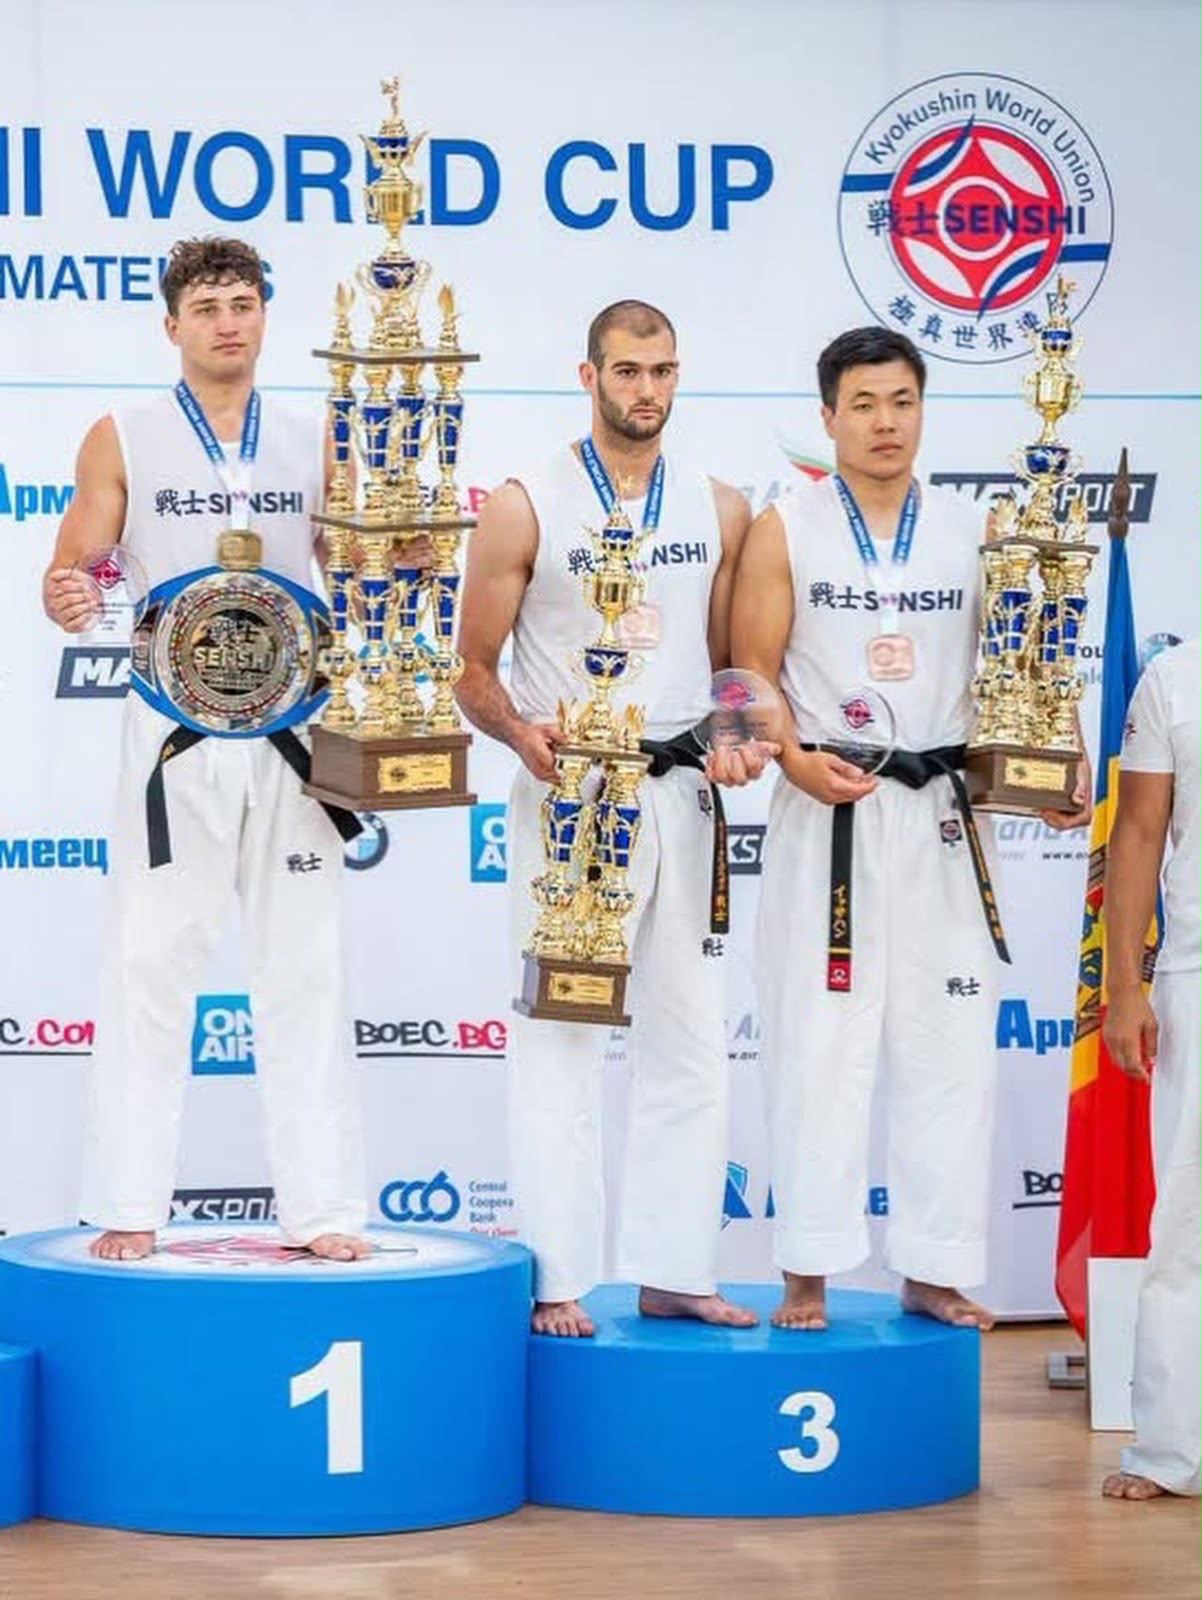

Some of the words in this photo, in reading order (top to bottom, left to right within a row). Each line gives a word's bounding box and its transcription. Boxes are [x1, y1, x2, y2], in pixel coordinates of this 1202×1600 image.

[544, 140, 774, 231] CUP
[864, 88, 977, 164] Kyokushin
[985, 87, 1056, 136] World
[1052, 130, 1096, 204] Union
[290, 1341, 363, 1474] 1
[778, 1391, 839, 1473] 3
